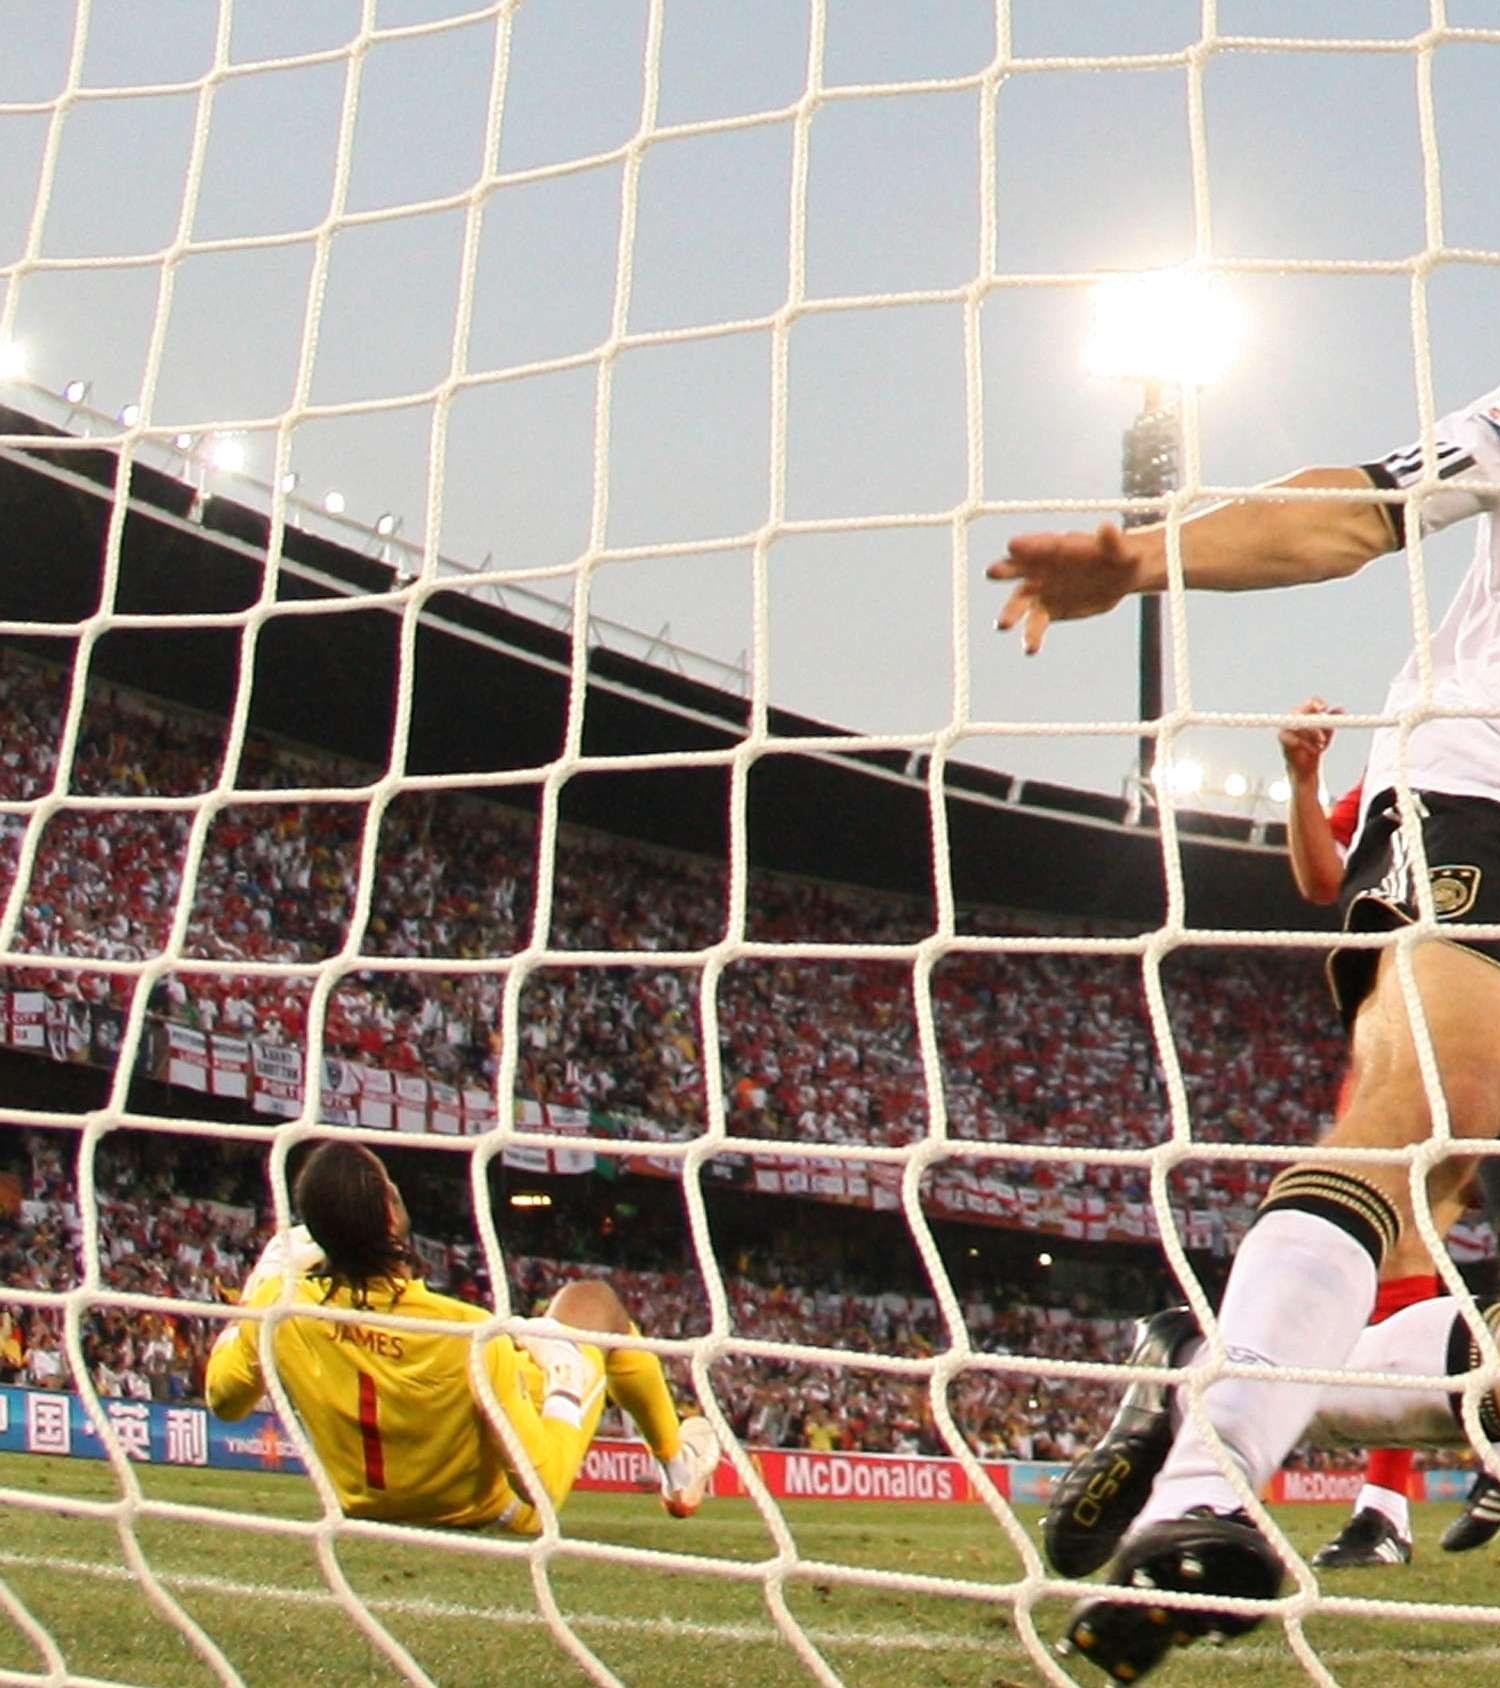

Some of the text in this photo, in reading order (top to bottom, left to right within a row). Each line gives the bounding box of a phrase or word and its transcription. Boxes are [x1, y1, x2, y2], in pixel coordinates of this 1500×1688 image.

[328, 1322, 404, 1360] JAMES
[357, 1370, 386, 1491] 1
[785, 1455, 953, 1499] McDonald's
[1284, 1471, 1366, 1500] McDonal
